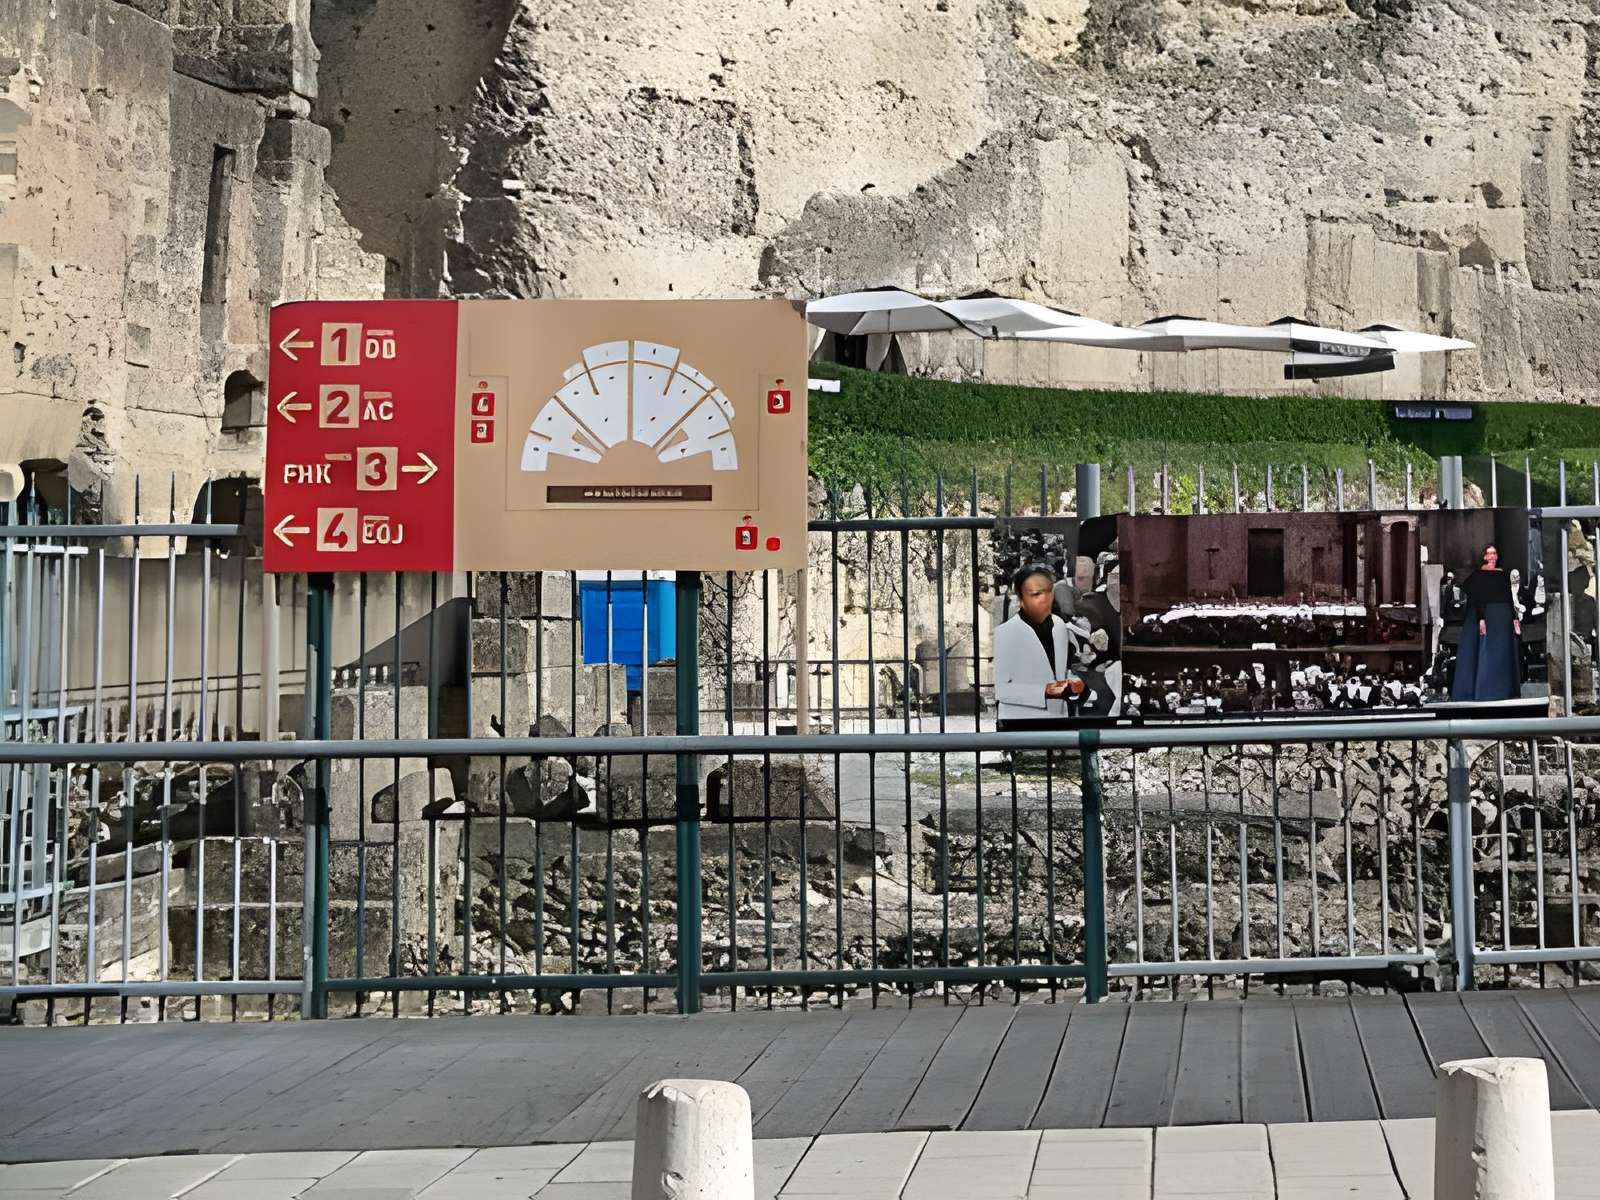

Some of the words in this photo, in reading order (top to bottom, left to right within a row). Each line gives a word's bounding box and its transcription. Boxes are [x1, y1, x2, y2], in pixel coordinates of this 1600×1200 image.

[330, 327, 348, 362] 1
[326, 390, 350, 424] 2
[364, 452, 387, 486] 3
[323, 512, 349, 549] 4
